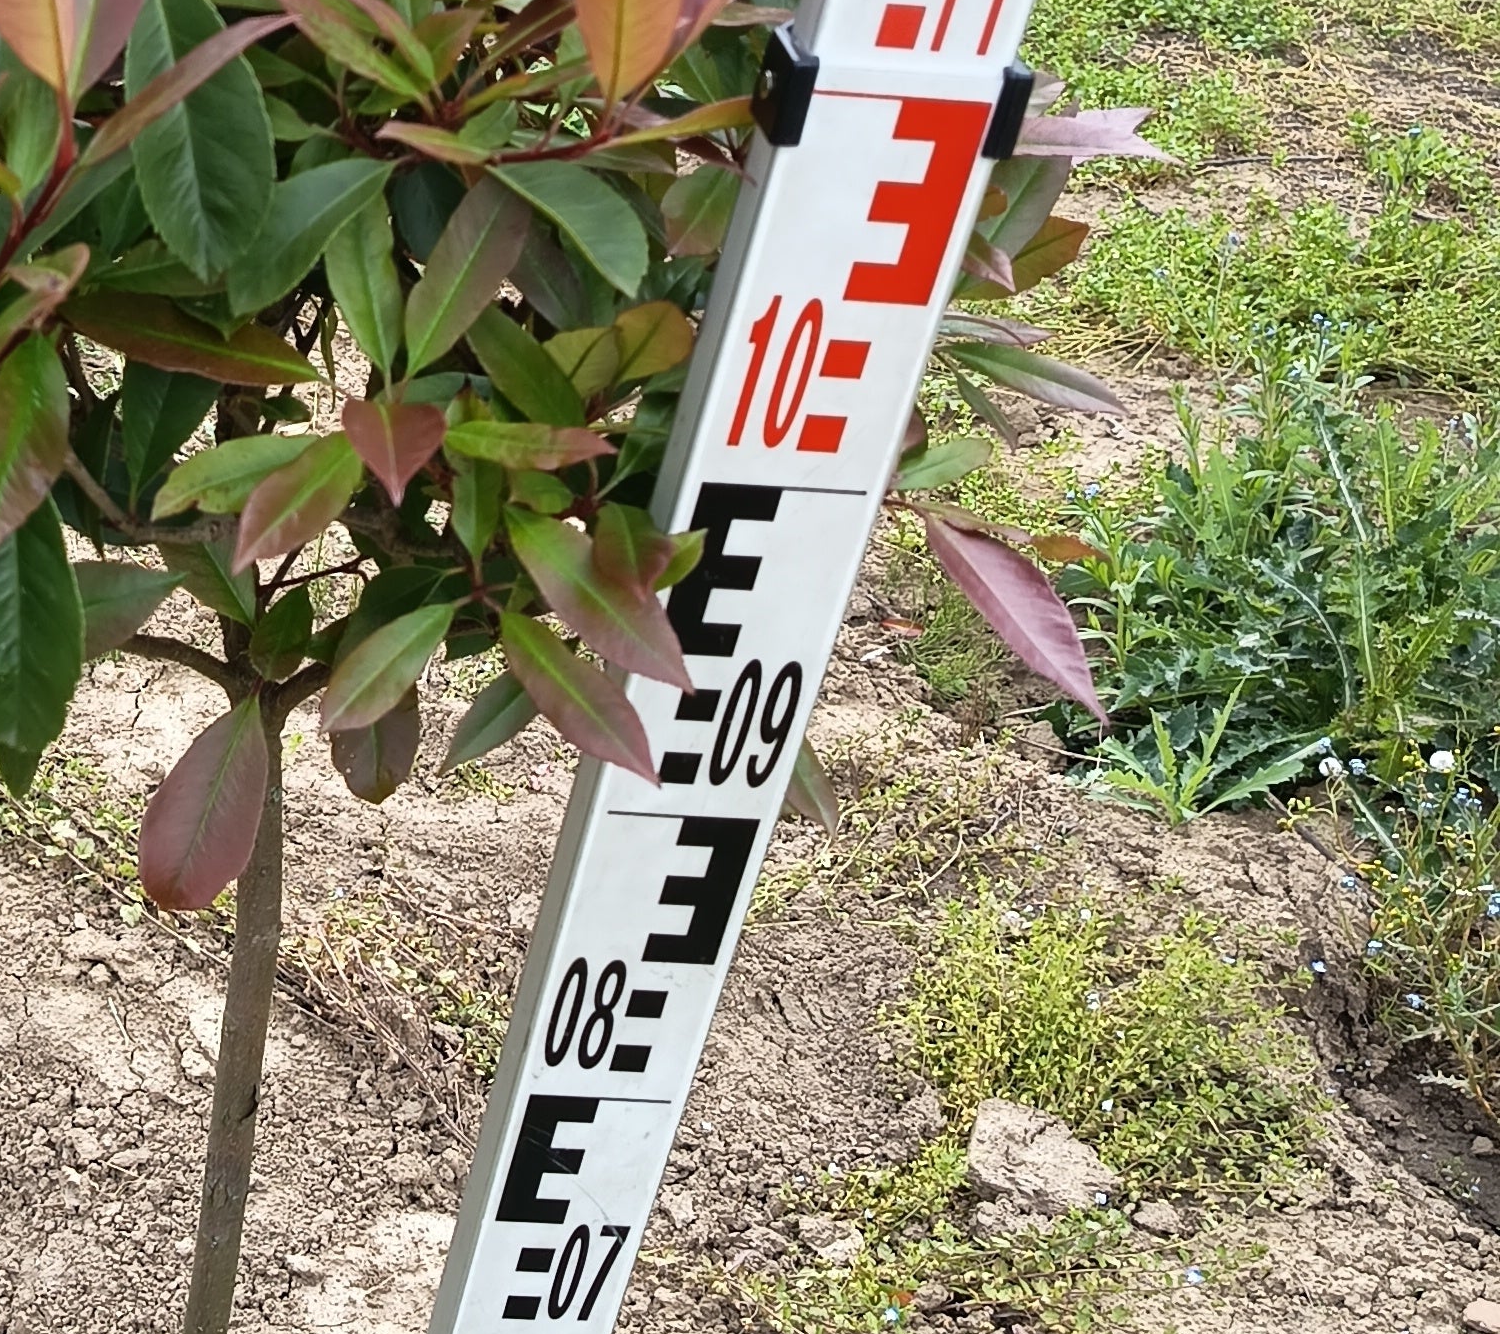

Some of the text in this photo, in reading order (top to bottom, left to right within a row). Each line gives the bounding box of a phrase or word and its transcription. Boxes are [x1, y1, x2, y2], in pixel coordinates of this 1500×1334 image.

[727, 294, 823, 448] 10
[710, 658, 802, 788] 09
[544, 956, 627, 1070] 08
[547, 1223, 630, 1323] 07
